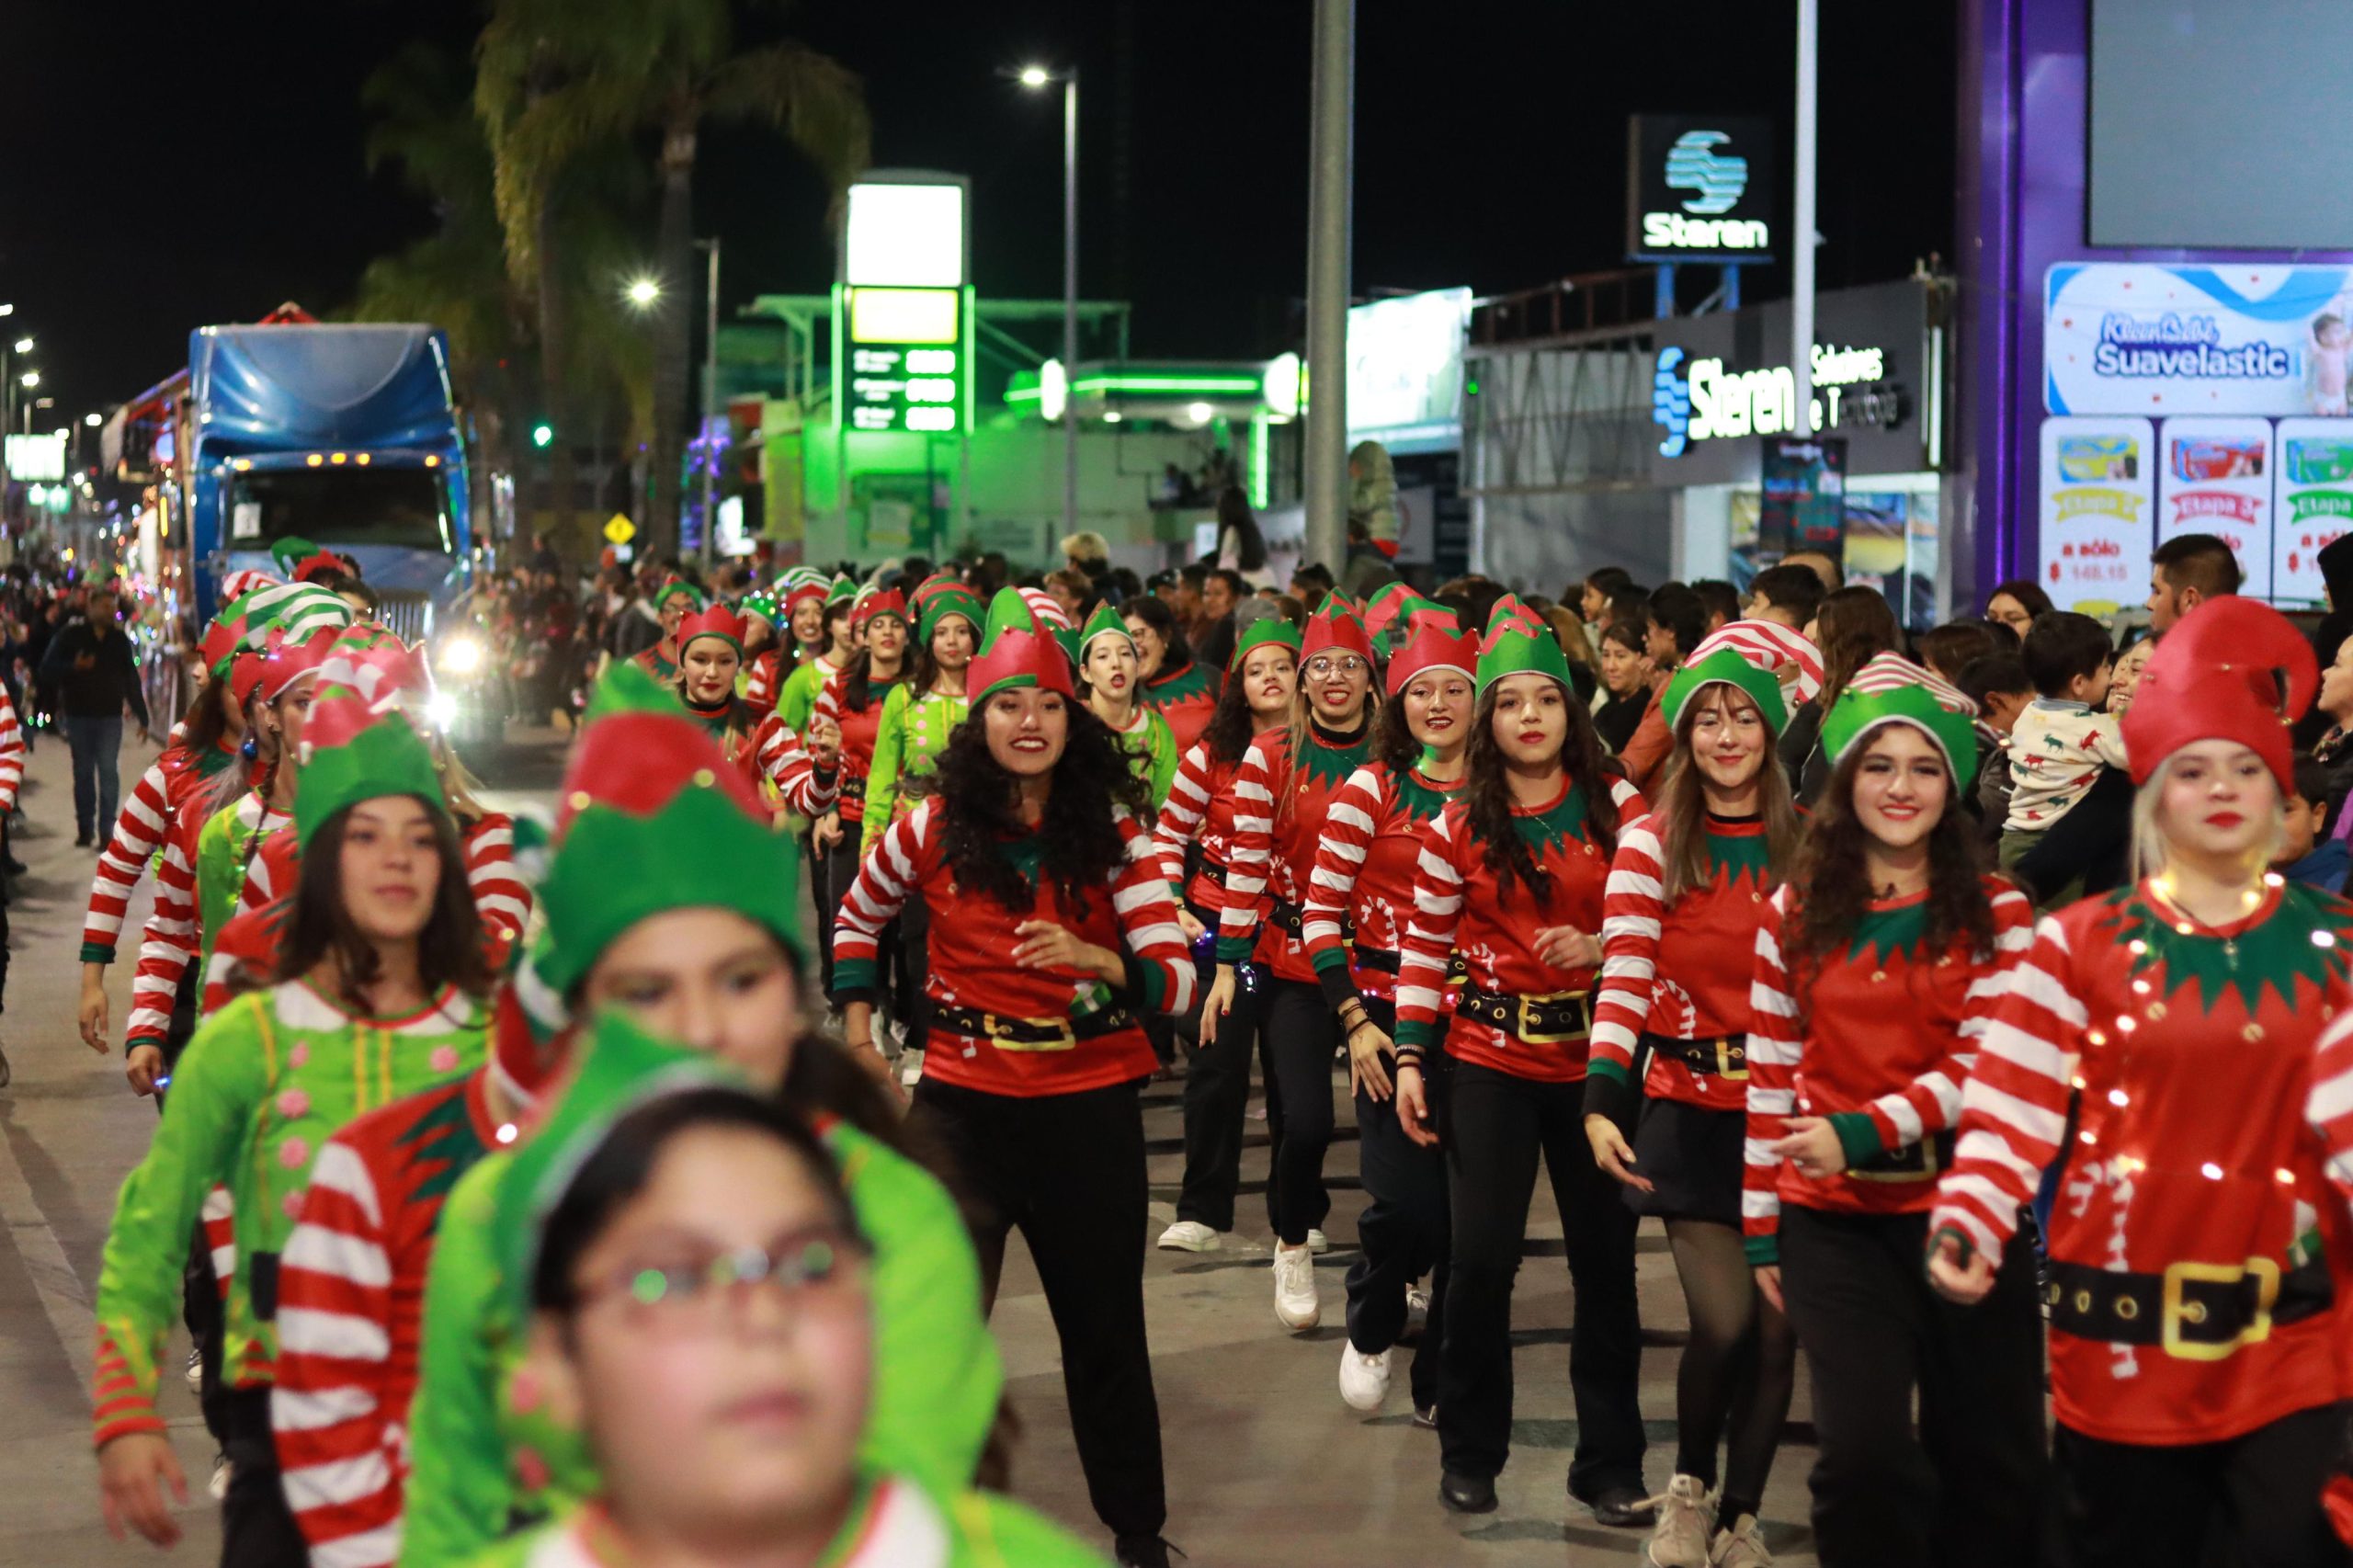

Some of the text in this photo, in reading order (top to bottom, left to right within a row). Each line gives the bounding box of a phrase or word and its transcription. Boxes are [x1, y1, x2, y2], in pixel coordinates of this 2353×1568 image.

[1643, 212, 1768, 247] Steren
[2096, 342, 2288, 377] Suavelastic
[1688, 358, 1795, 440] Steren
